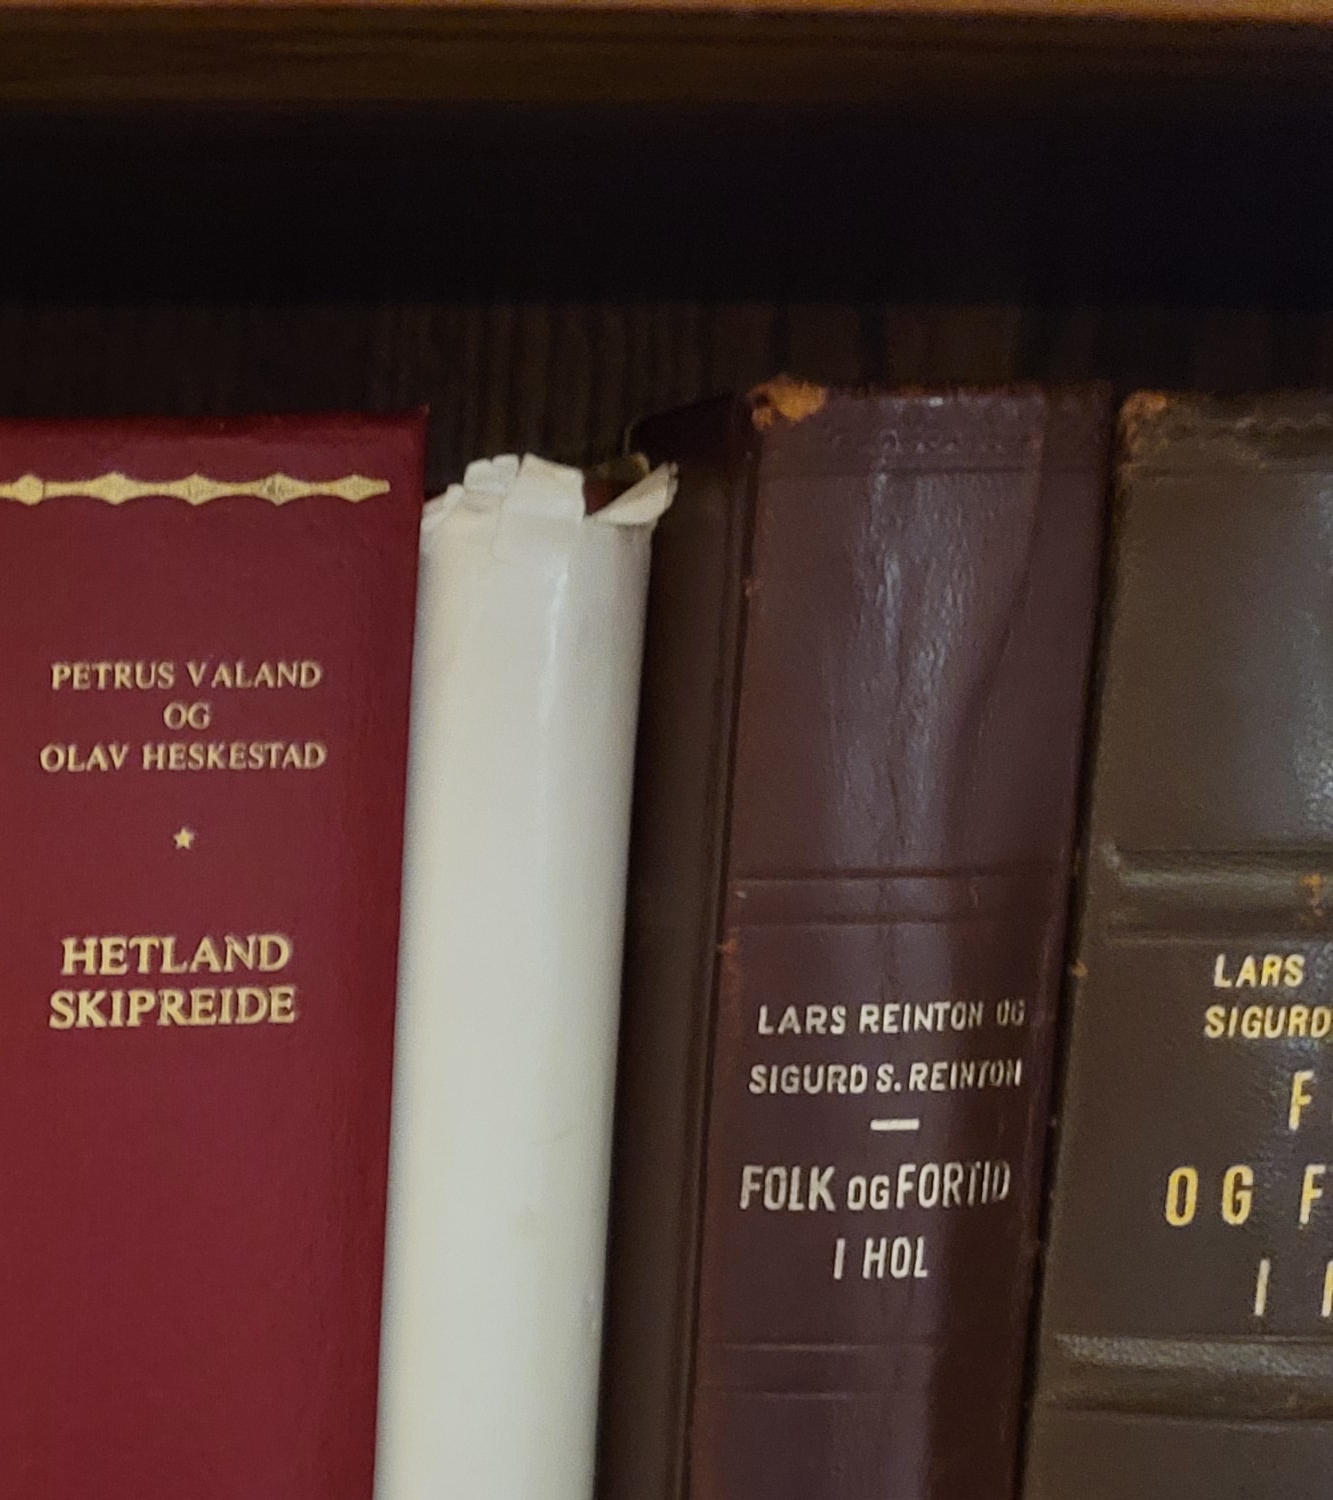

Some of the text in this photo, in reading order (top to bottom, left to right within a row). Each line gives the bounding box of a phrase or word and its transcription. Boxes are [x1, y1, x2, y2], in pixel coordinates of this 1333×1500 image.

[50, 659, 322, 691] PETRUS VALAND
[163, 702, 211, 730] OG
[39, 742, 328, 772] OLAV HESKESTAD
[61, 933, 292, 976] HETLAND
[1213, 952, 1305, 989] LARS
[49, 985, 297, 1030] SKIPREIDE
[757, 1004, 847, 1035] LARS
[858, 1000, 983, 1034] REINTON
[1203, 1003, 1333, 1039] SIGURD
[748, 1058, 1023, 1095] SIGURD S. REINTON
[739, 1164, 837, 1212] FOLK
[896, 1161, 1011, 1209] FORTID
[1164, 1164, 1255, 1228] OG
[833, 1236, 929, 1280] I HOL
[1254, 1257, 1271, 1318] I
